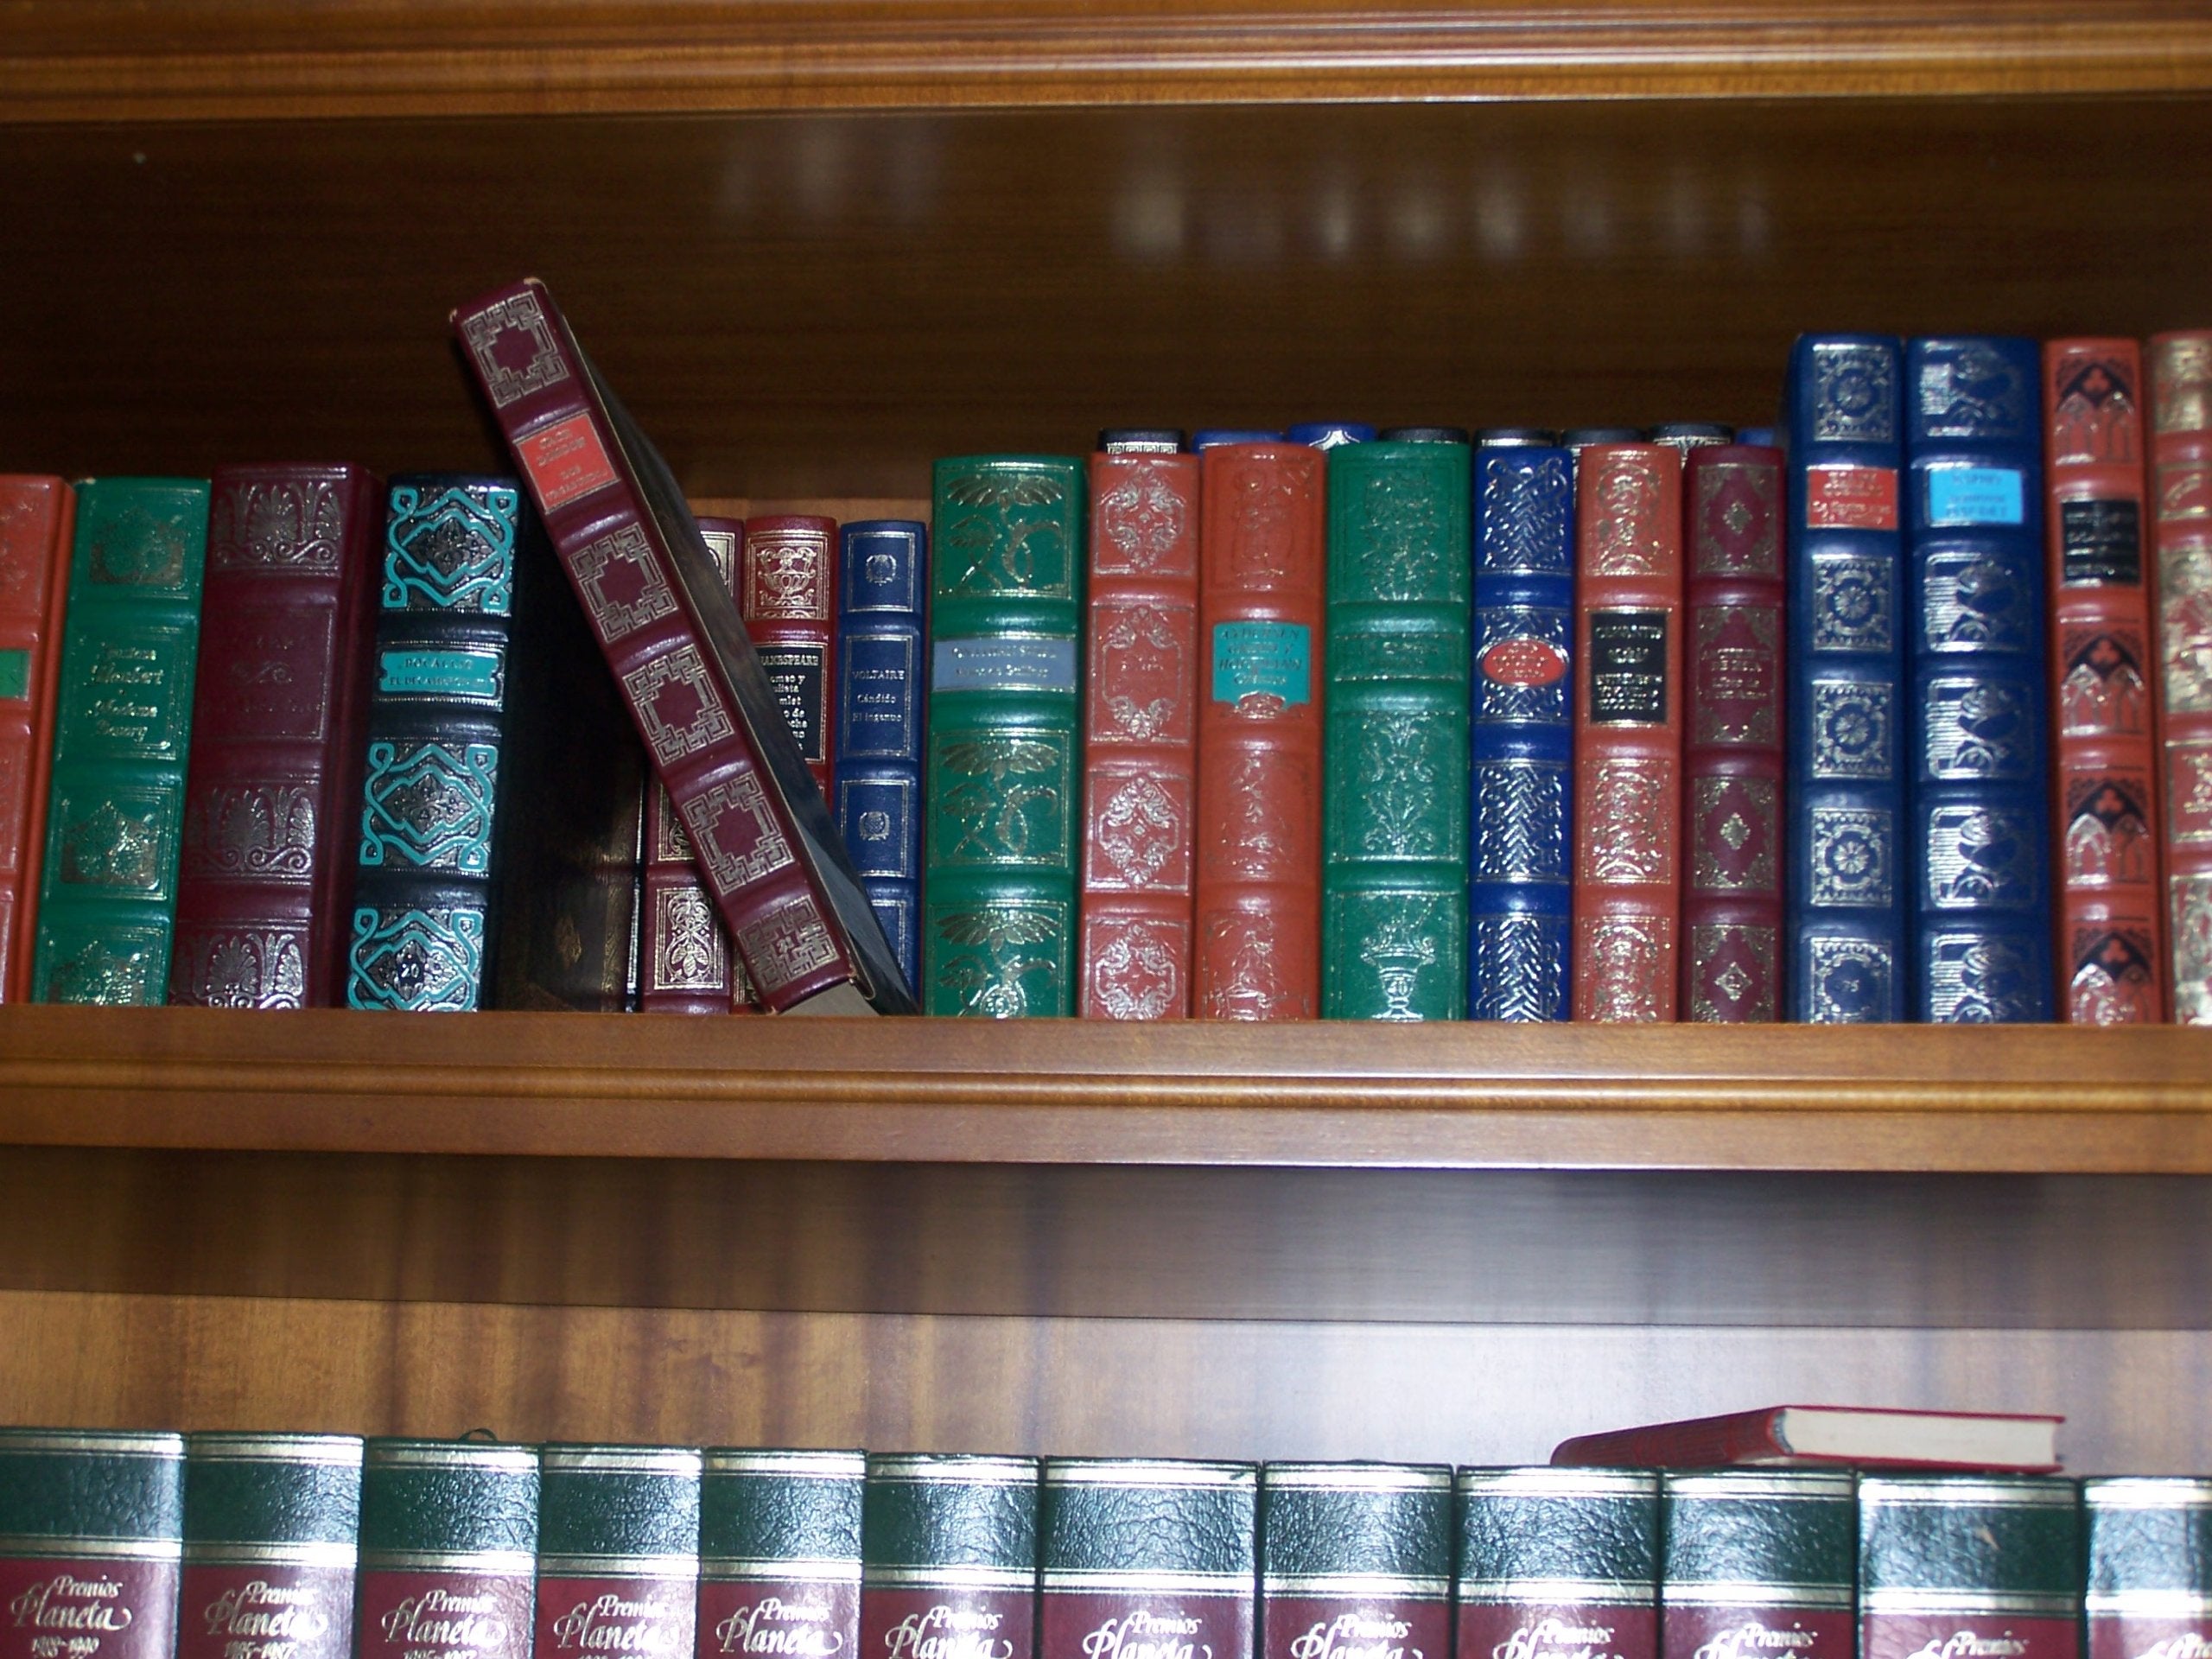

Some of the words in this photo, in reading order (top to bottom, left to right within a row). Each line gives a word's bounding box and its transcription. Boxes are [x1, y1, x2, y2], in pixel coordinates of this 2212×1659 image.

[760, 655, 819, 665] HAKESPEARE
[851, 670, 906, 680] VOLTAIRE
[54, 1574, 124, 1598] Premios
[245, 1580, 319, 1605] Premios
[10, 1579, 133, 1632] Planeta
[425, 1589, 499, 1613] Premios
[597, 1594, 670, 1618] Premios
[761, 1598, 831, 1622] Premios
[204, 1588, 329, 1641] Planeta
[381, 1596, 509, 1648] Planeta
[553, 1601, 680, 1653] Planeta
[929, 1605, 1003, 1630] Premios
[1129, 1610, 1202, 1635] Premios
[1337, 1613, 1413, 1639] Premios
[715, 1605, 843, 1656] Planeta
[885, 1612, 1014, 1659] Planeta
[1540, 1618, 1615, 1644] Premios
